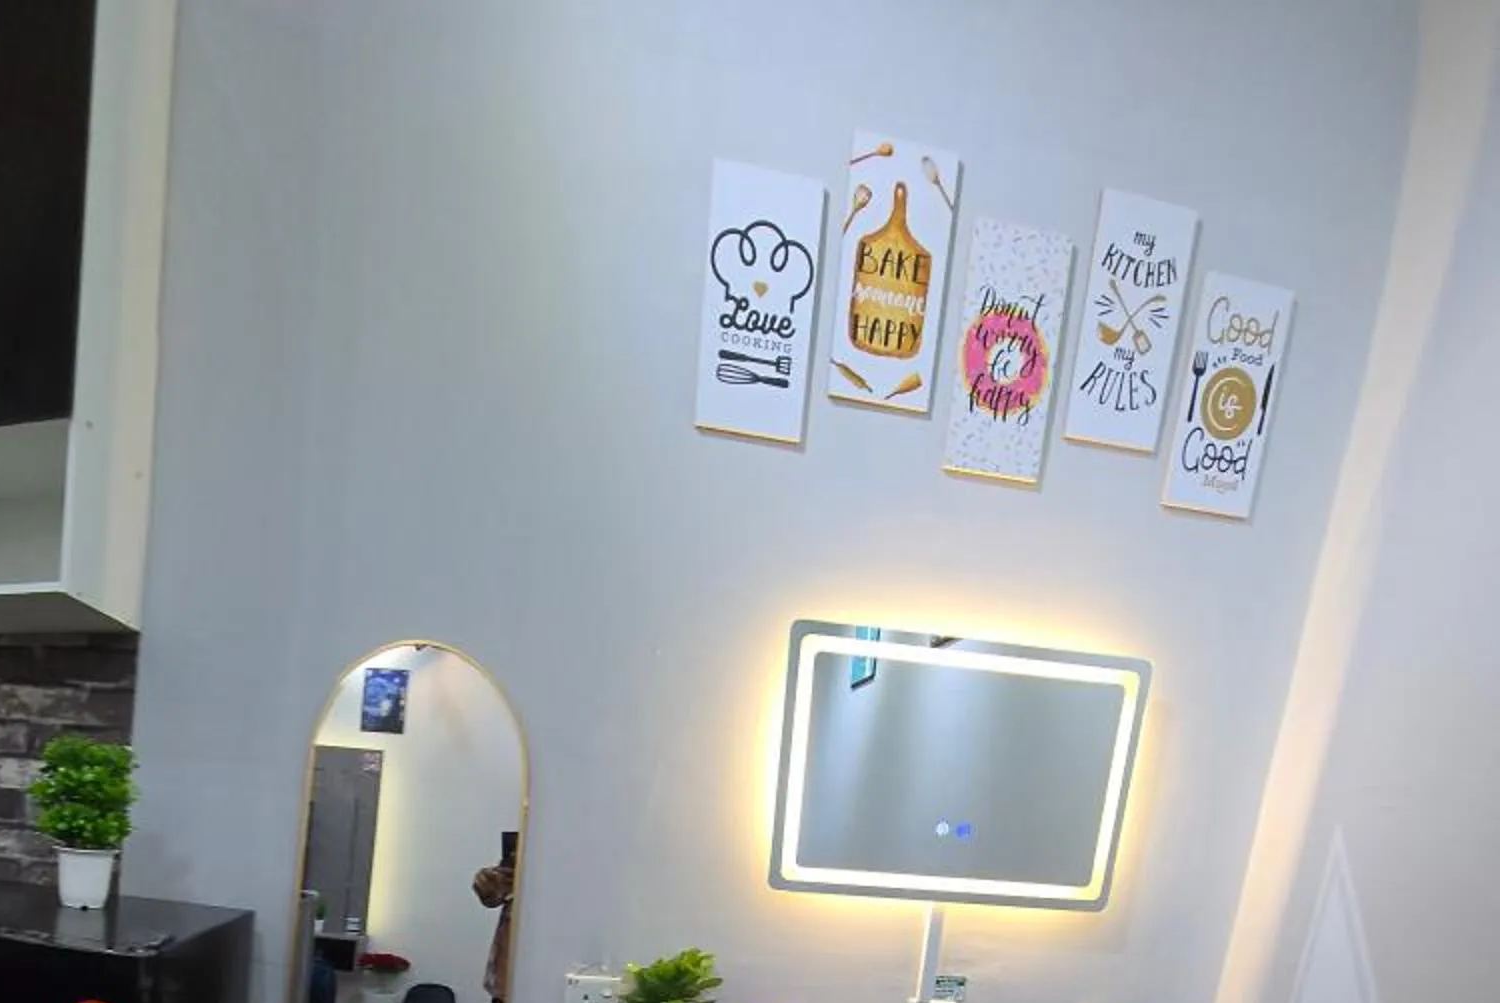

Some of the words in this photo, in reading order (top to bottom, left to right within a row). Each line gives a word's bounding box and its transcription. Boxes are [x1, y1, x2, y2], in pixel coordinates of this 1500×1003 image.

[859, 241, 932, 285] BAKE
[1102, 243, 1178, 289] KITCHEN
[719, 297, 796, 339] Love
[852, 313, 922, 350] HAPPY
[720, 331, 792, 354] COOKING
[1080, 361, 1158, 412] RULES
